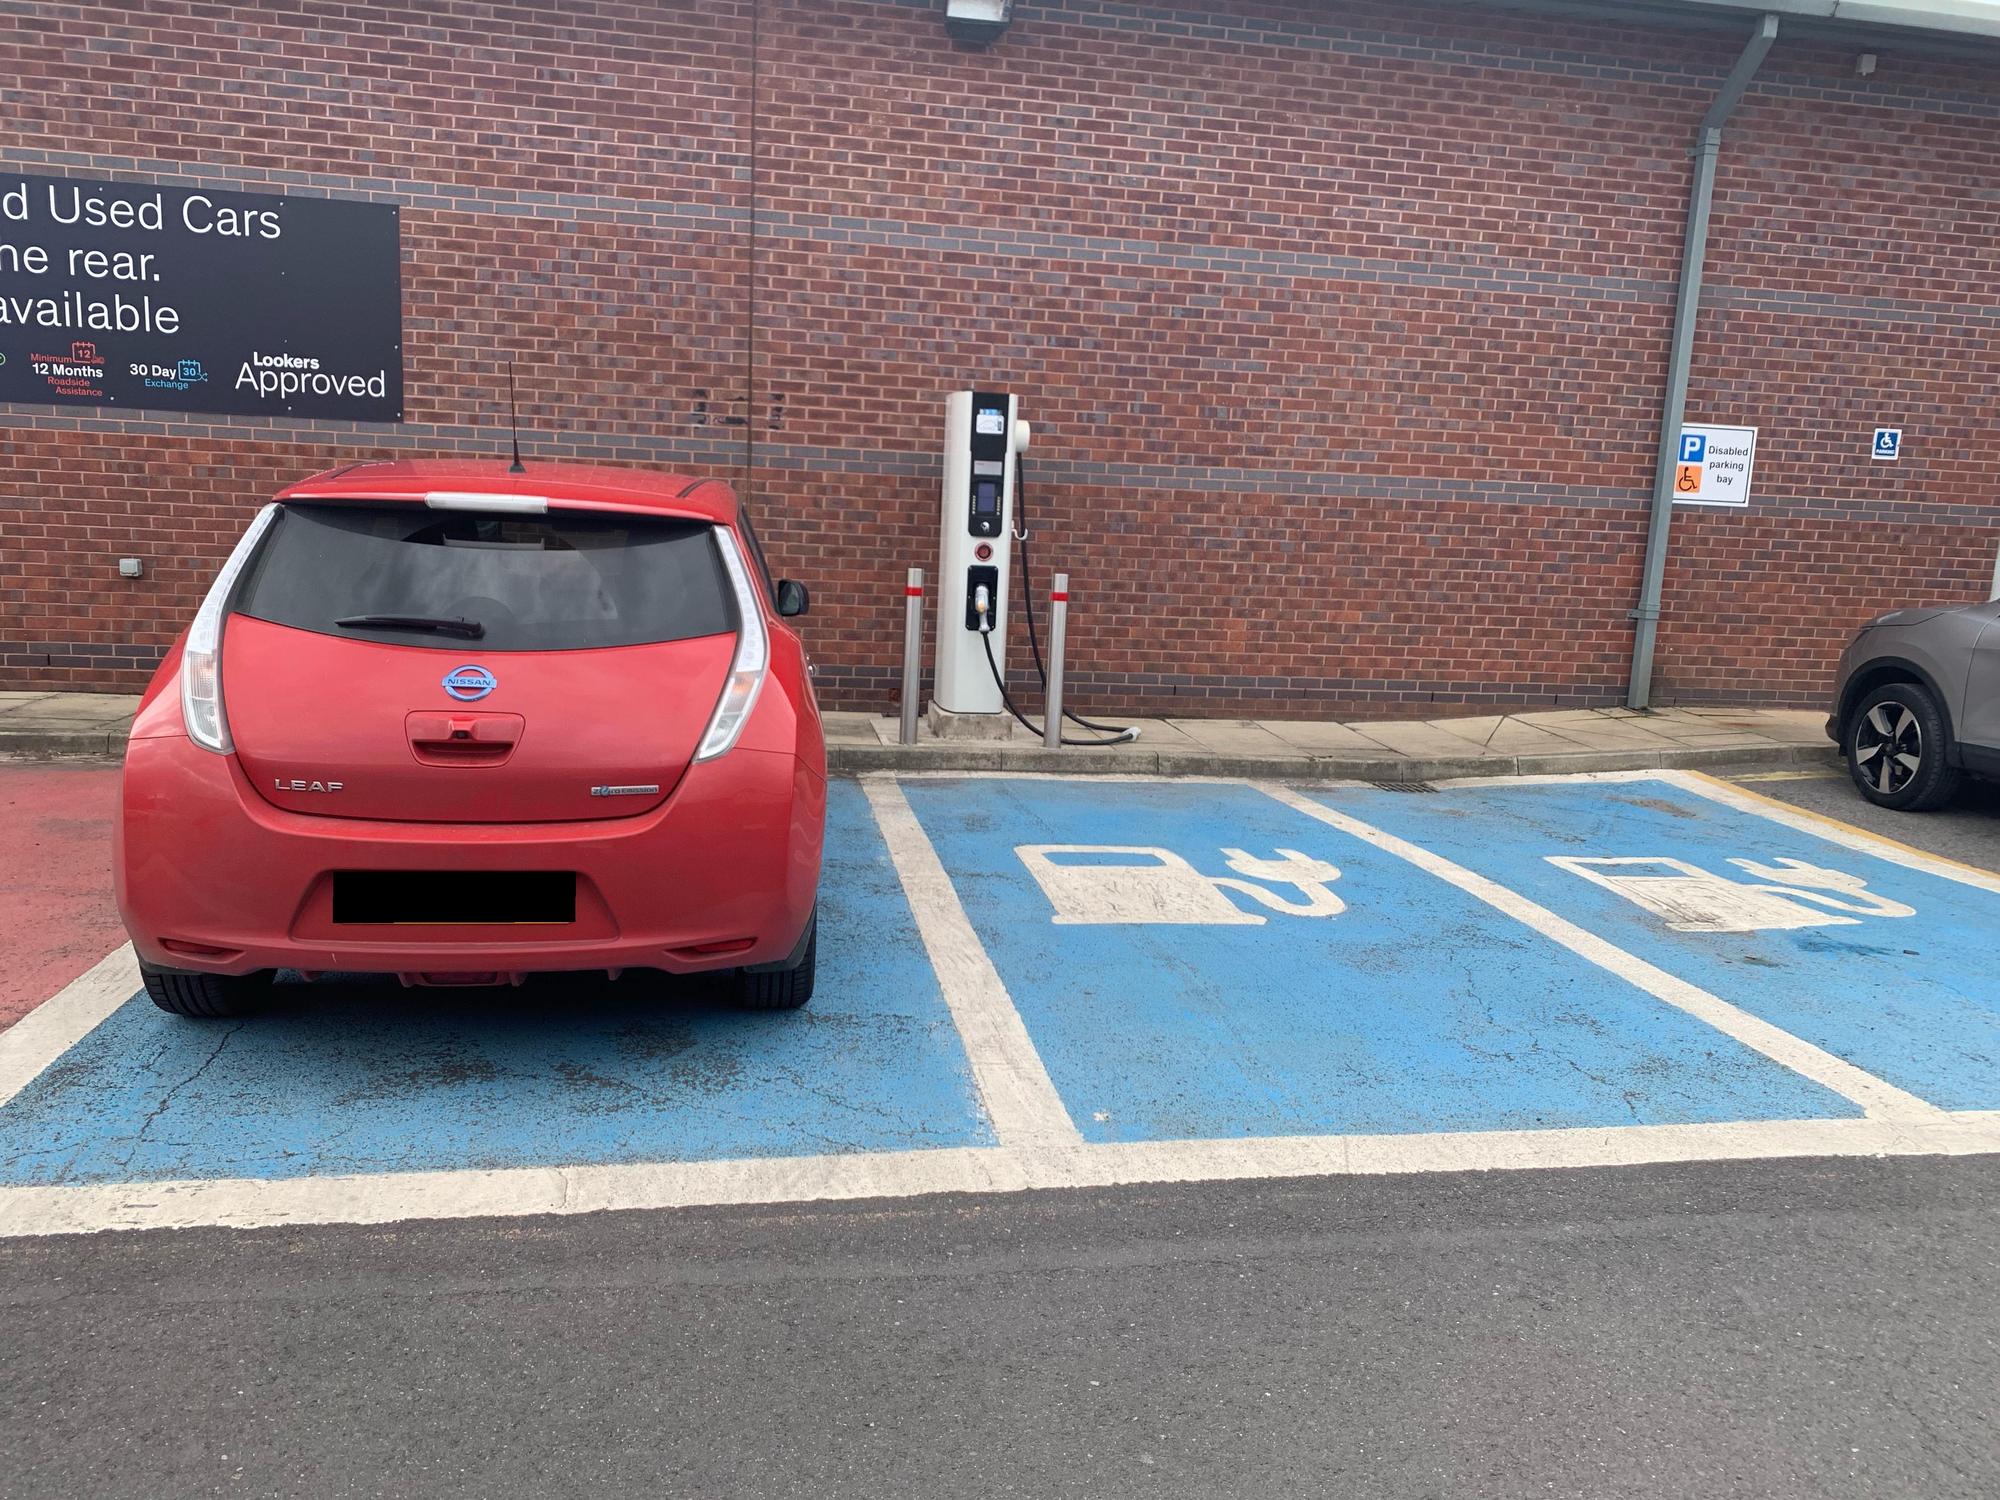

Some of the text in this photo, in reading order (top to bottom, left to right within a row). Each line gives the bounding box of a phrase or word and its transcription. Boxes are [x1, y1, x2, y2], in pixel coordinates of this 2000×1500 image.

[2, 182, 281, 238] d Used Cars
[69, 248, 160, 282] rear.
[30, 353, 72, 364] Minimum
[253, 352, 320, 370] Lookers
[32, 363, 104, 378] 12 Months
[129, 363, 177, 380] 30 Day
[183, 367, 196, 376] 30
[47, 376, 91, 387] Roadside
[145, 378, 189, 390] Exchange
[235, 362, 386, 399] Approved
[55, 386, 103, 397] Assistance
[1683, 436, 1701, 460] P
[1708, 445, 1749, 457] Disabled
[1709, 459, 1744, 472] parking
[1716, 474, 1733, 485] bay
[447, 678, 491, 686] NISSAN
[274, 778, 344, 793] LEAF
